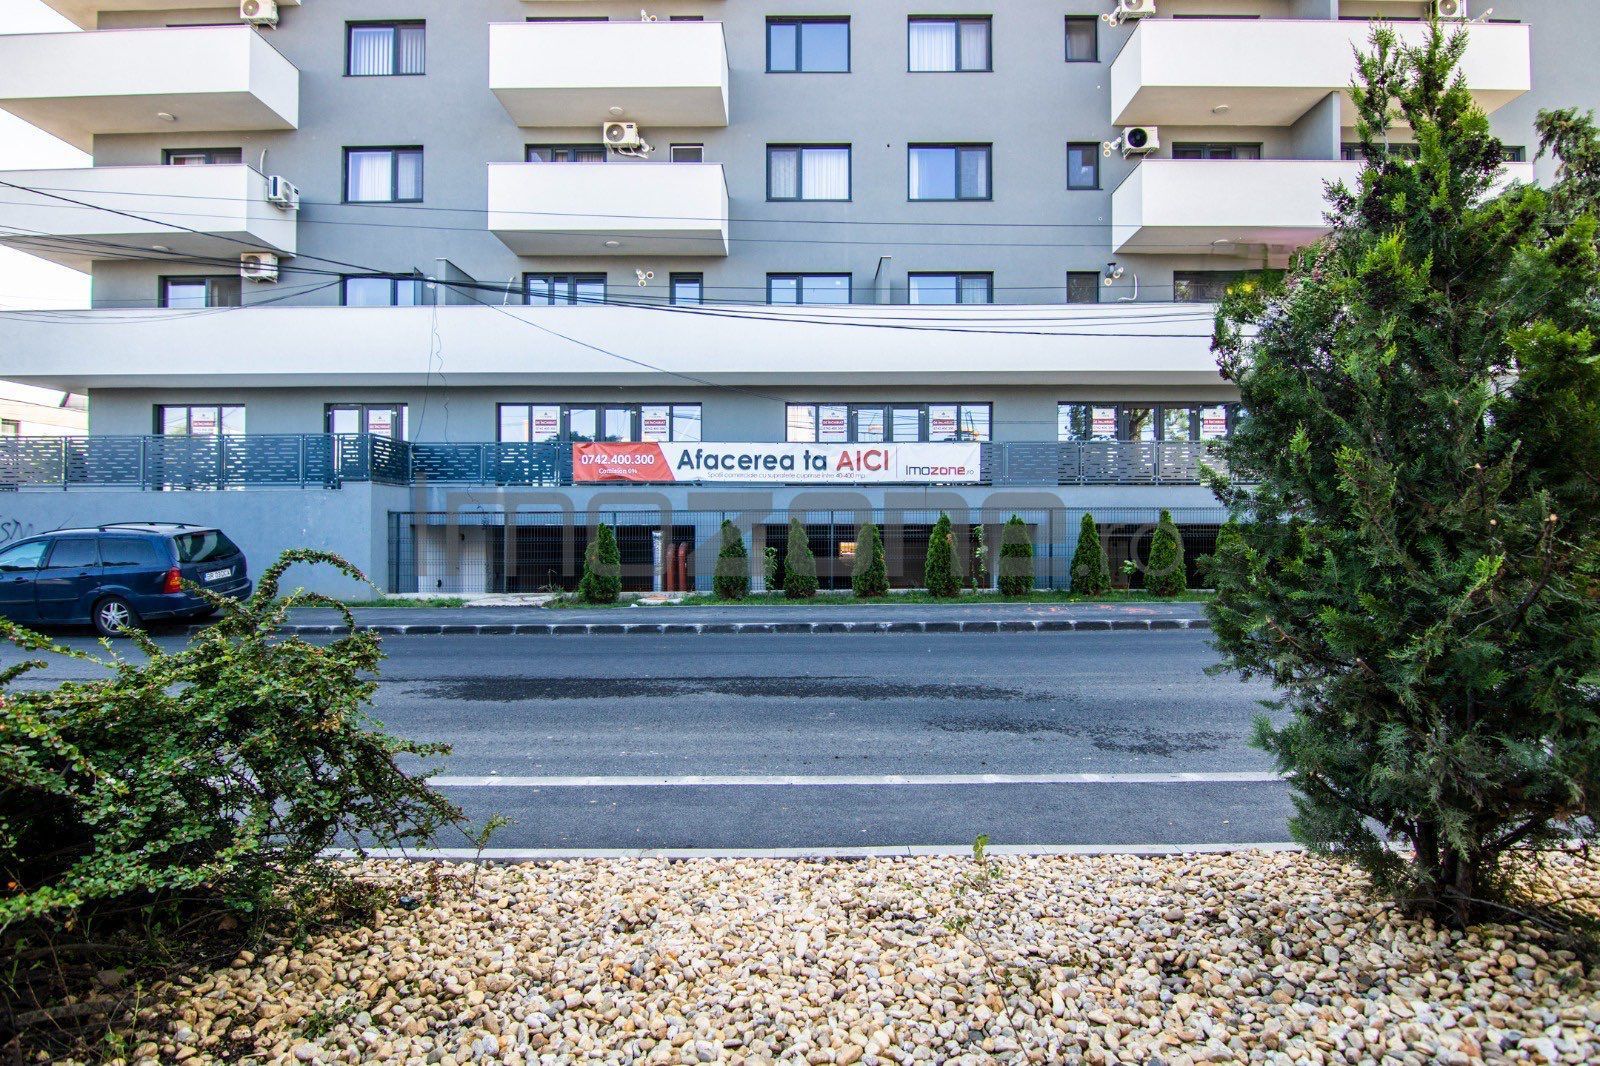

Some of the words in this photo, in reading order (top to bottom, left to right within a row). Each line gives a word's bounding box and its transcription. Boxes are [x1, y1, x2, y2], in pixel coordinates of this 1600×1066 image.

[581, 454, 655, 464] 0742.400.300
[676, 448, 795, 470] Afacerea
[804, 450, 826, 470] ta
[836, 449, 889, 472] AICI
